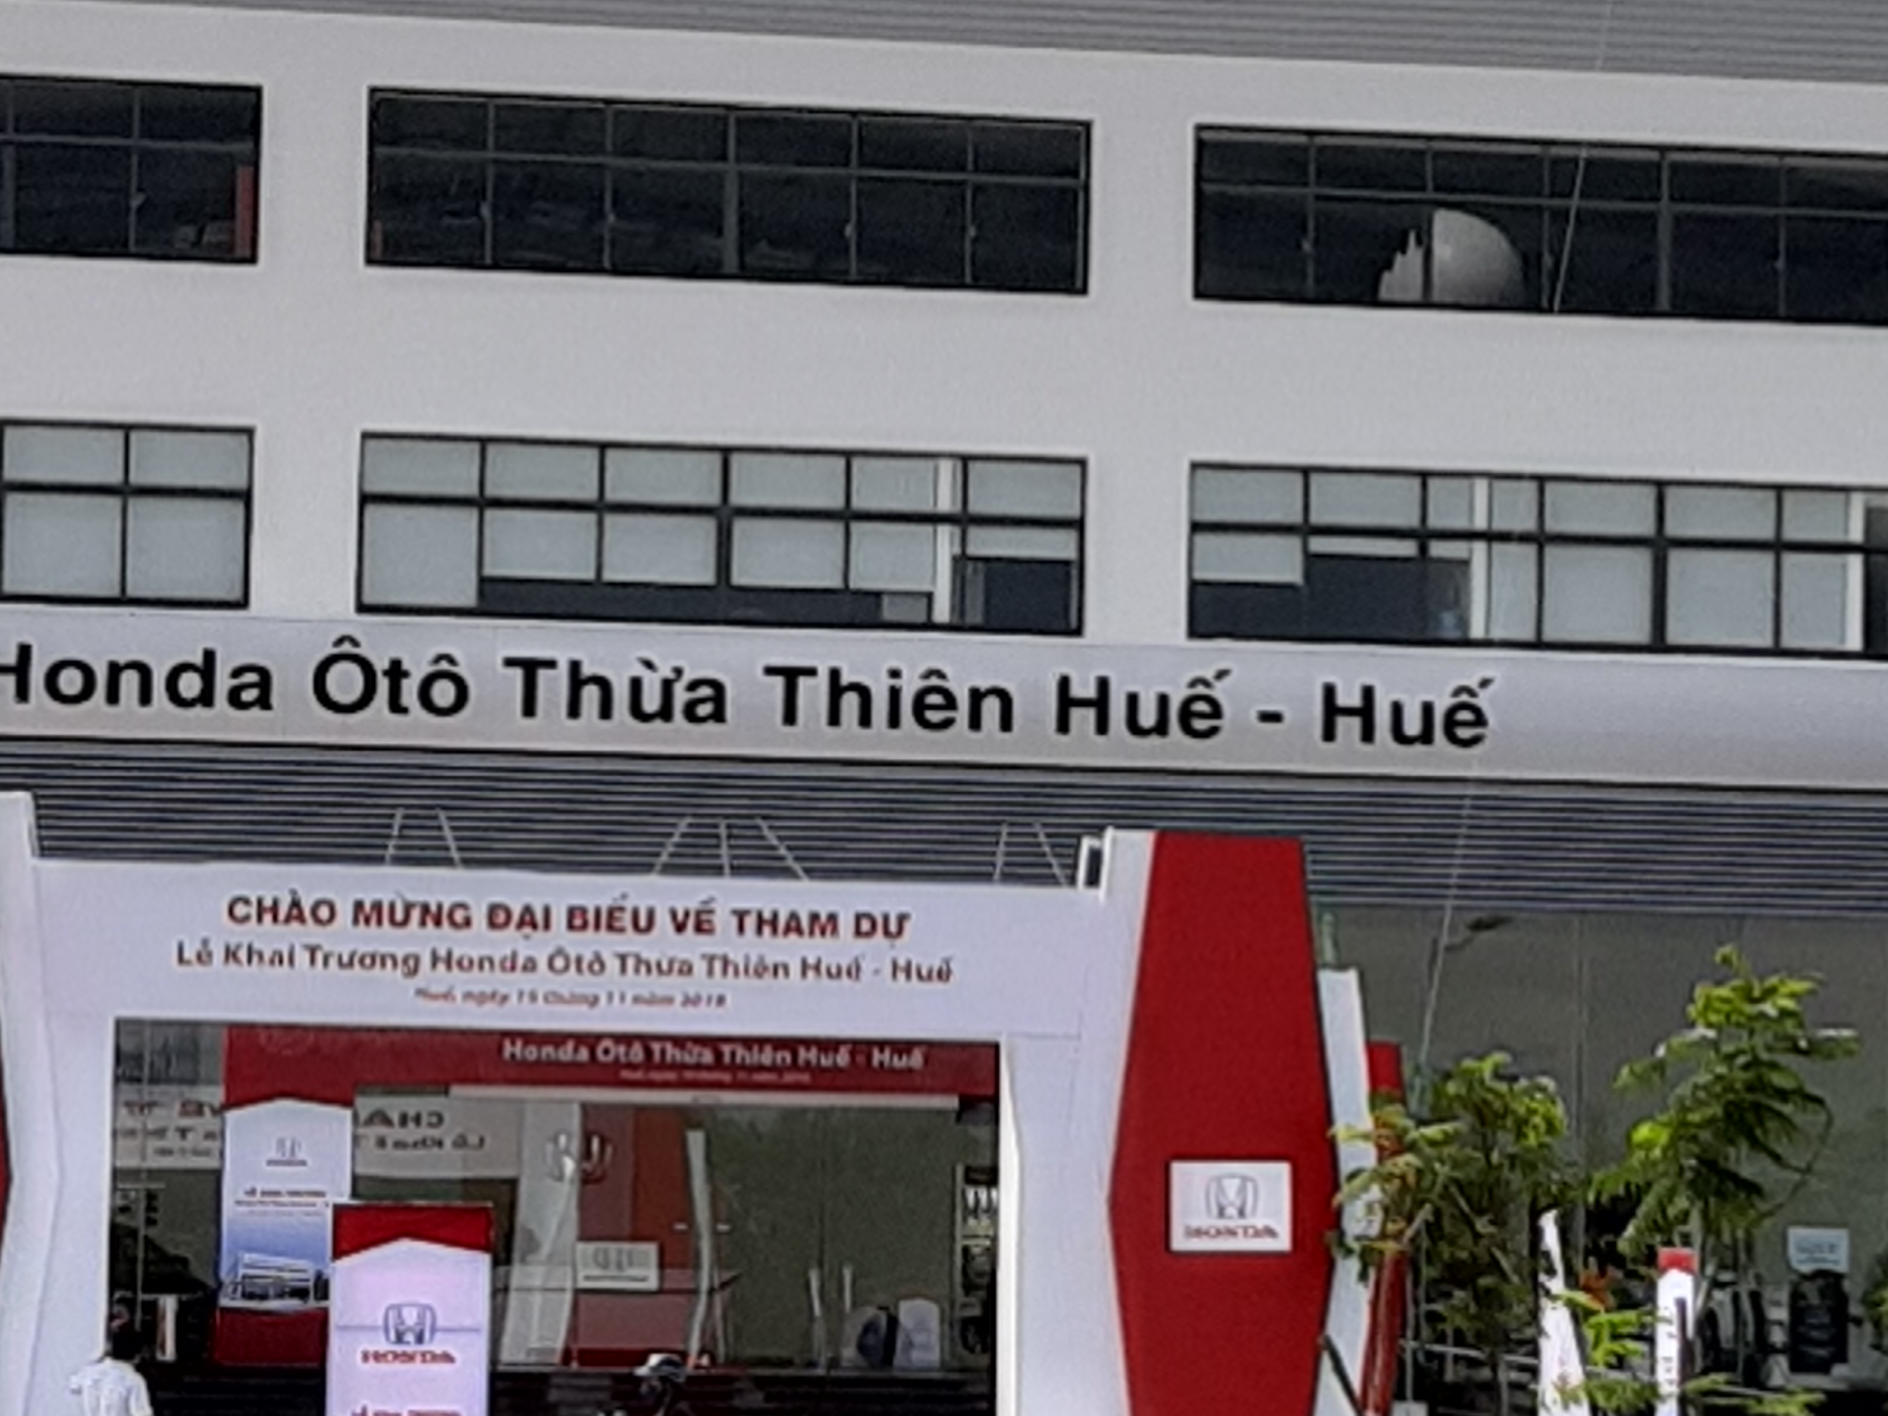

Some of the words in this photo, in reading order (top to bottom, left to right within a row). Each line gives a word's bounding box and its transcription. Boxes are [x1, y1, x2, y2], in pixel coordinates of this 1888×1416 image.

[311, 634, 470, 718] Ôtô
[501, 656, 729, 725] Thừa
[762, 665, 1015, 733] Thiên
[1053, 668, 1232, 740] Huế
[1320, 677, 1495, 749] Huế
[351, 889, 472, 930] MỪNG
[730, 907, 841, 939] THAM
[852, 911, 911, 948] DỰ
[223, 941, 297, 970] Khai
[302, 943, 421, 979] Trương
[430, 946, 538, 975] Honda
[502, 1038, 590, 1063] Honda
[1184, 1224, 1279, 1241] HONDA
